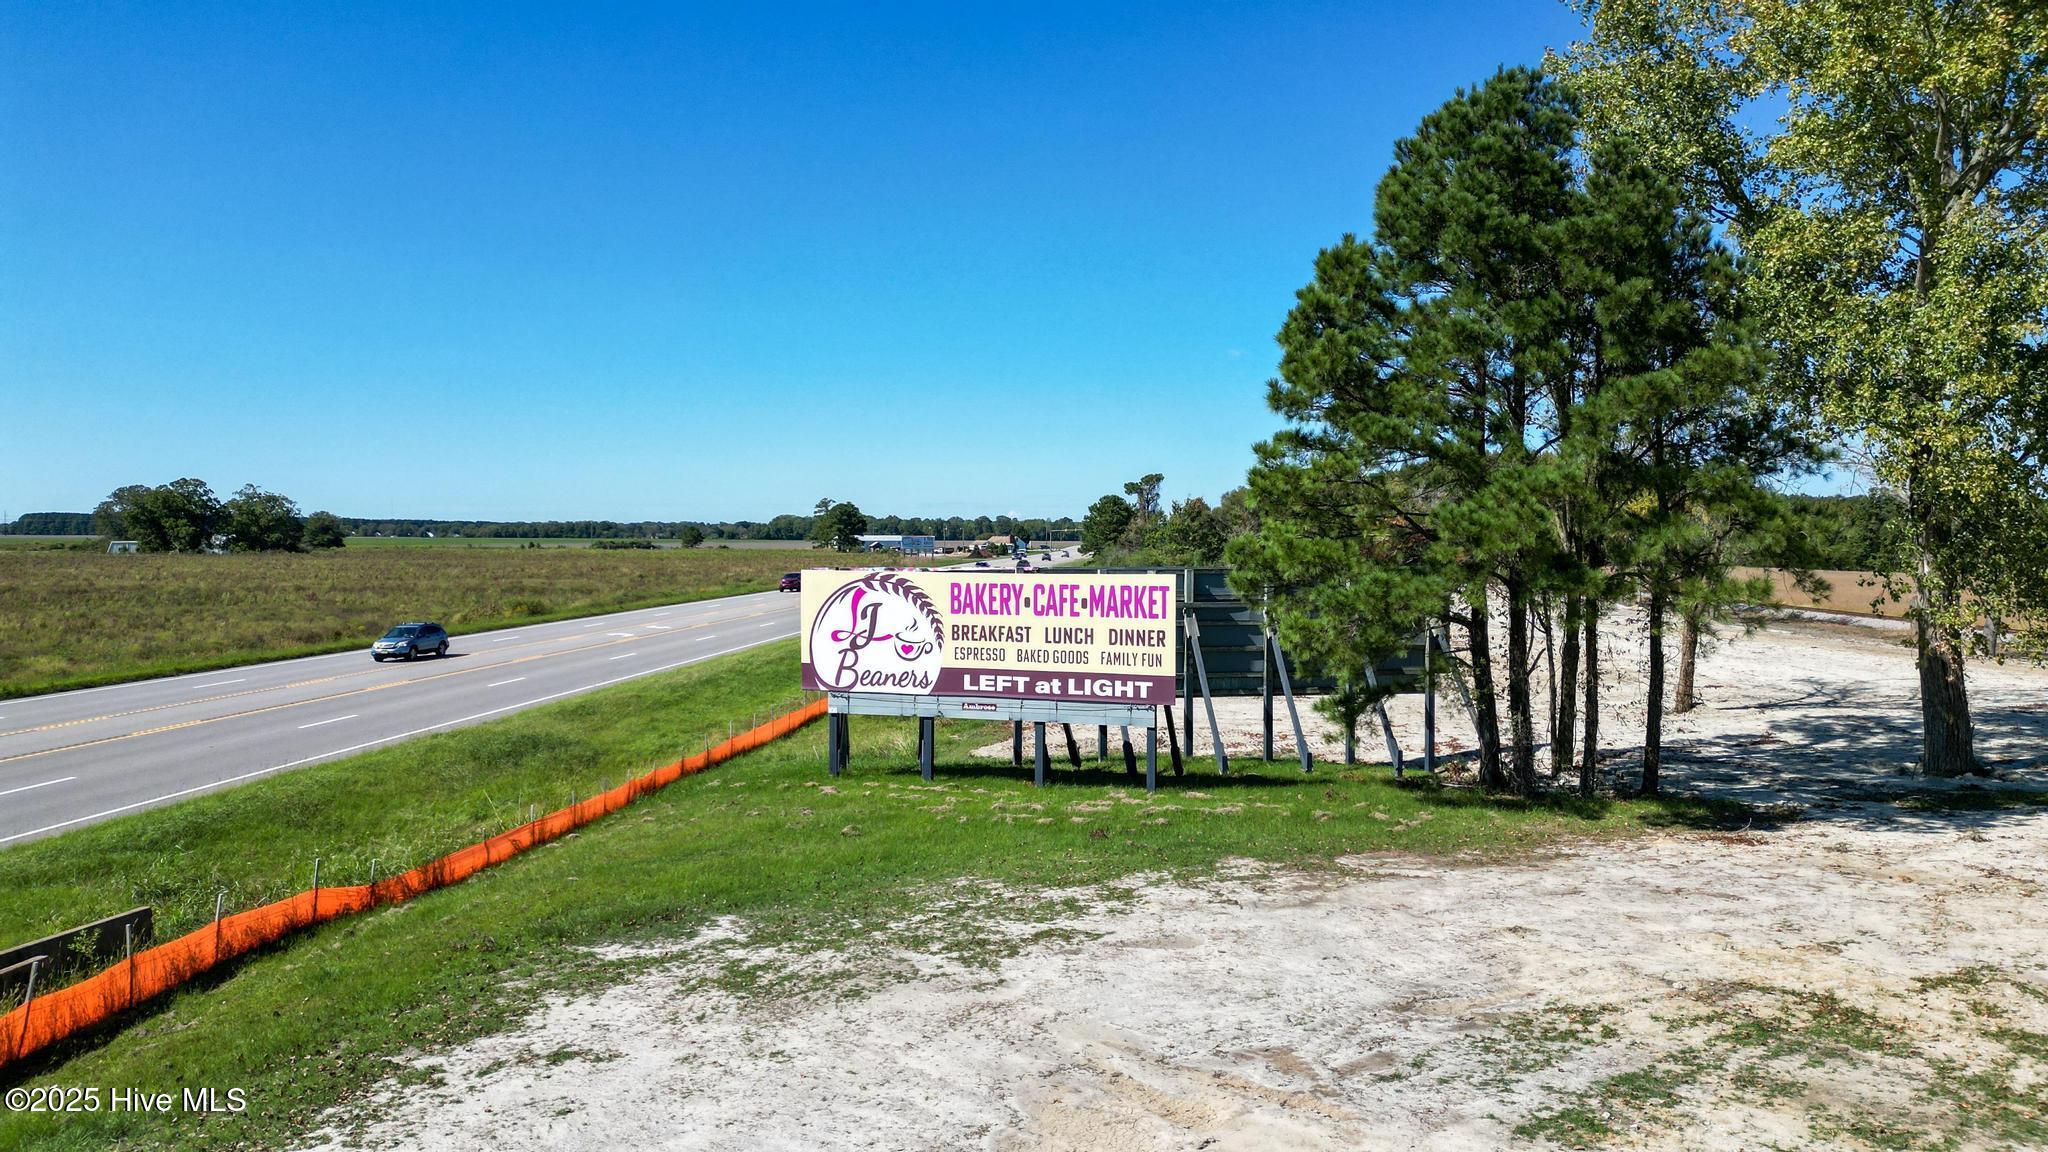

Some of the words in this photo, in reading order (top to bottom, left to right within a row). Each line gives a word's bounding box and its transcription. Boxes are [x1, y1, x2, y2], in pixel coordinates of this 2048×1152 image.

[950, 582, 1024, 616] BAKERY
[1033, 583, 1081, 617] CAFE
[1089, 584, 1170, 619] MARKET
[951, 624, 1032, 643] BREAKFAST
[1044, 627, 1094, 645] LUNCH
[1108, 628, 1166, 648] DINNER
[954, 646, 1006, 662] ESPRESSO
[1016, 648, 1050, 664] BAKED
[1052, 650, 1089, 665] GOODS
[1100, 651, 1138, 667] FAMILY
[1141, 653, 1163, 668] FUN
[835, 648, 933, 691] Beaners
[963, 674, 1030, 693] LEFT
[1035, 678, 1061, 695] at
[1067, 678, 1153, 698] LIGHT
[963, 703, 997, 712] Ambrose
